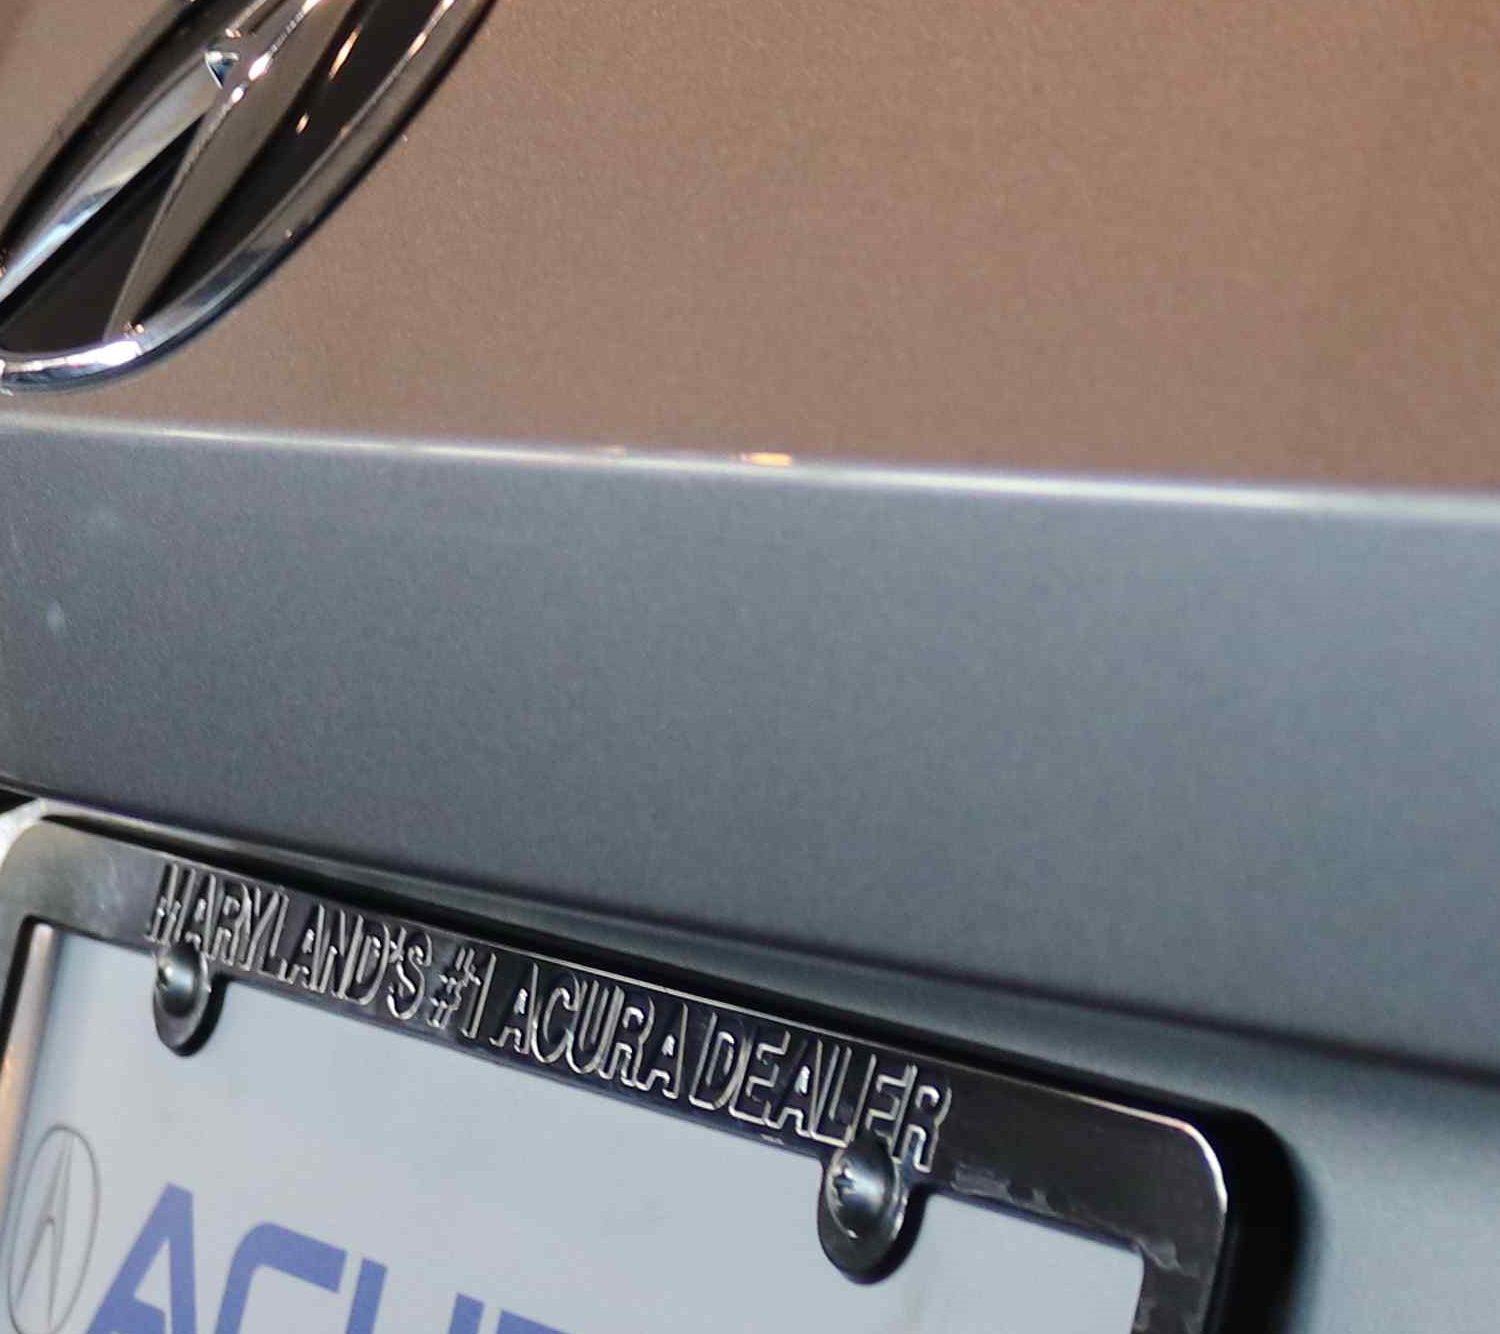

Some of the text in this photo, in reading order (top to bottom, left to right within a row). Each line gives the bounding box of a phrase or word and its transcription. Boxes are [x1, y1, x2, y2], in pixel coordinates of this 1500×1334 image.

[143, 860, 433, 1021] MARYLAND'S
[489, 961, 689, 1101] ACURA
[688, 1010, 954, 1175] DEALER
